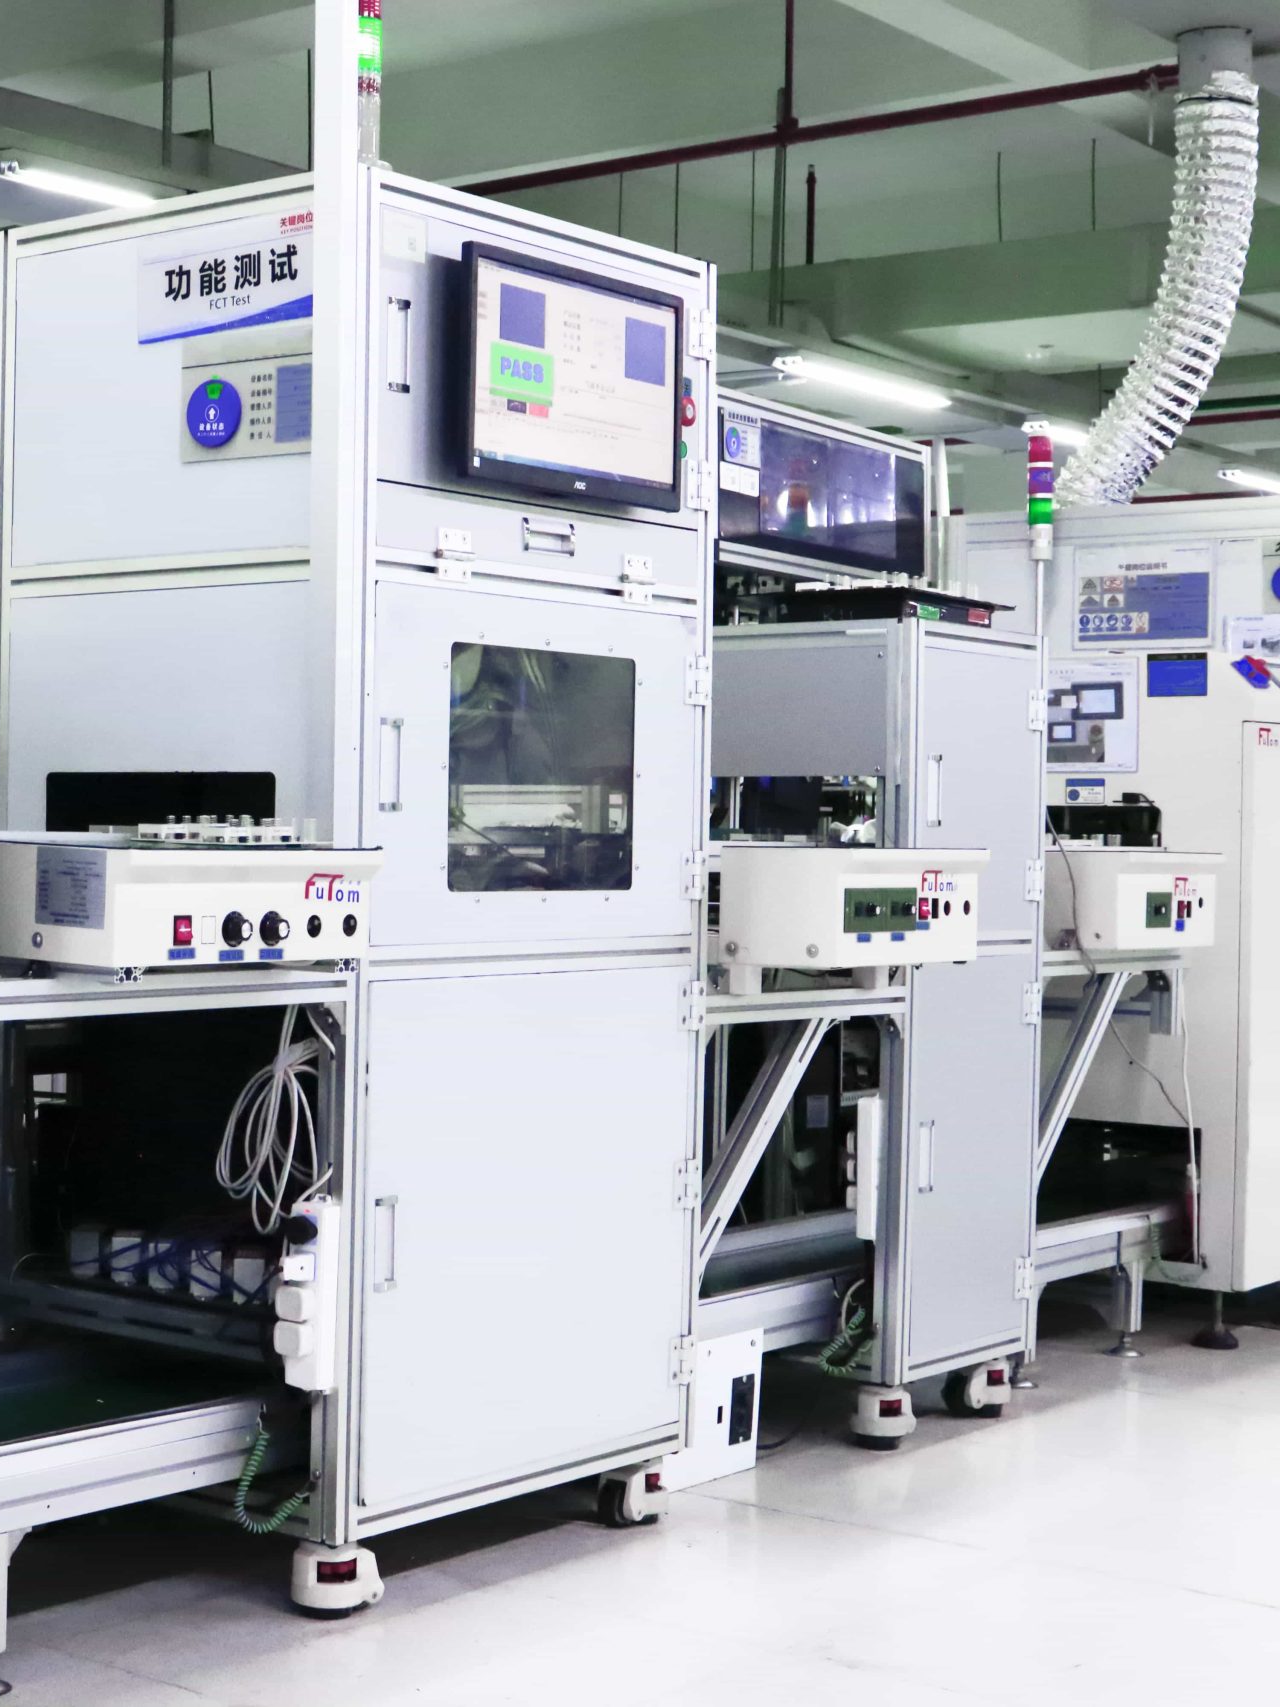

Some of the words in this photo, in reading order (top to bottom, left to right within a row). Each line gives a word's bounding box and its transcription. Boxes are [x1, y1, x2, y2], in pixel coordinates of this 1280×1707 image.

[280, 210, 313, 228] 关键岗位
[164, 244, 298, 302] 功能测试
[209, 297, 227, 310] FCT
[230, 294, 251, 307] Test
[500, 356, 545, 384] PASS
[573, 481, 587, 490] AOC
[305, 873, 360, 903] FuTom
[921, 870, 954, 892] FuTom
